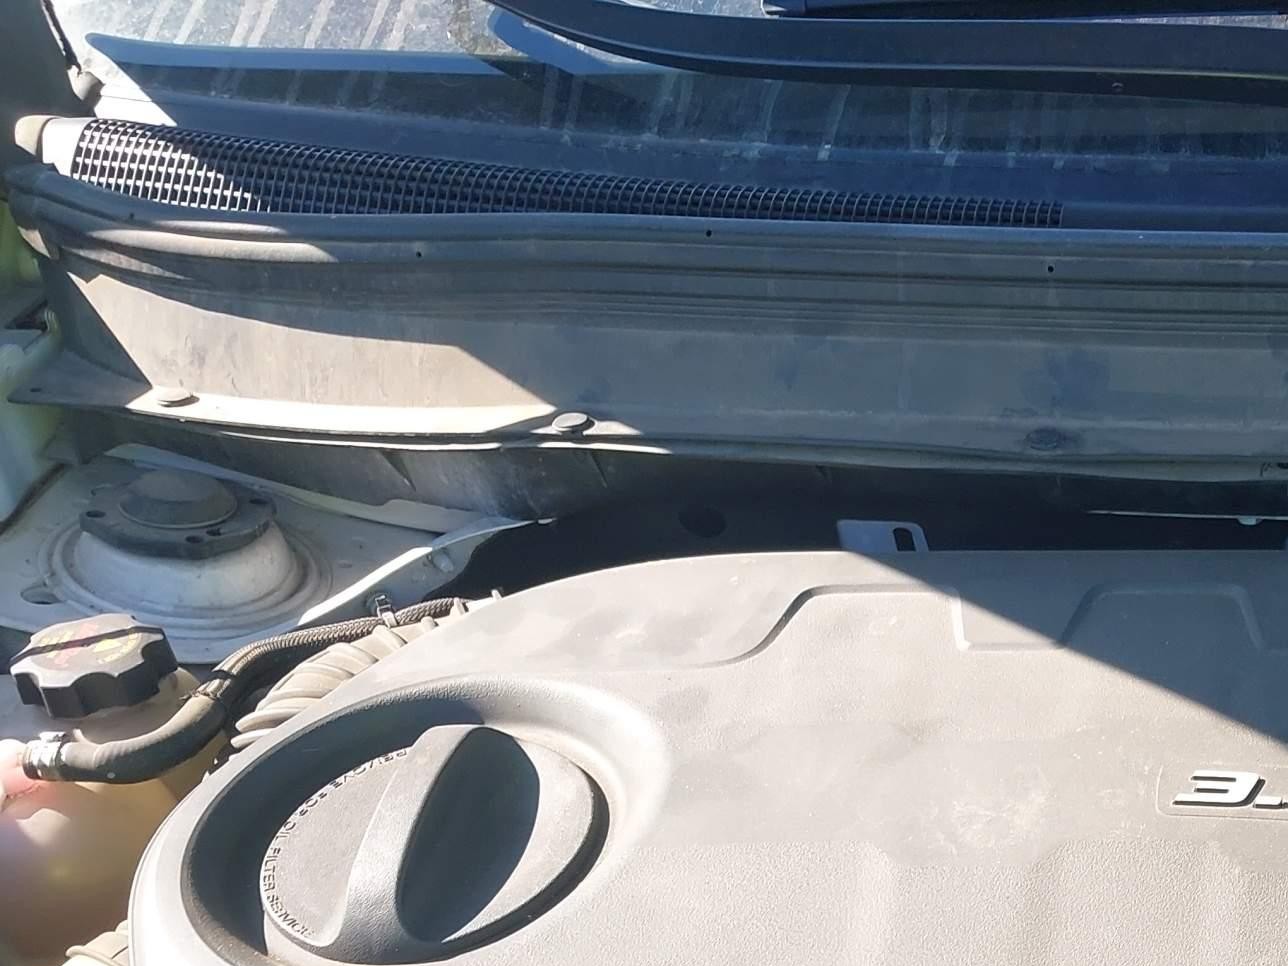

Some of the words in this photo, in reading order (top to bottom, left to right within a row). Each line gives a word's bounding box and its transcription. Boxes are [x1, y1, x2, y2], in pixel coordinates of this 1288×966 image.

[299, 791, 328, 817] FOR
[275, 819, 297, 841] OIL
[262, 847, 282, 893] FILTER
